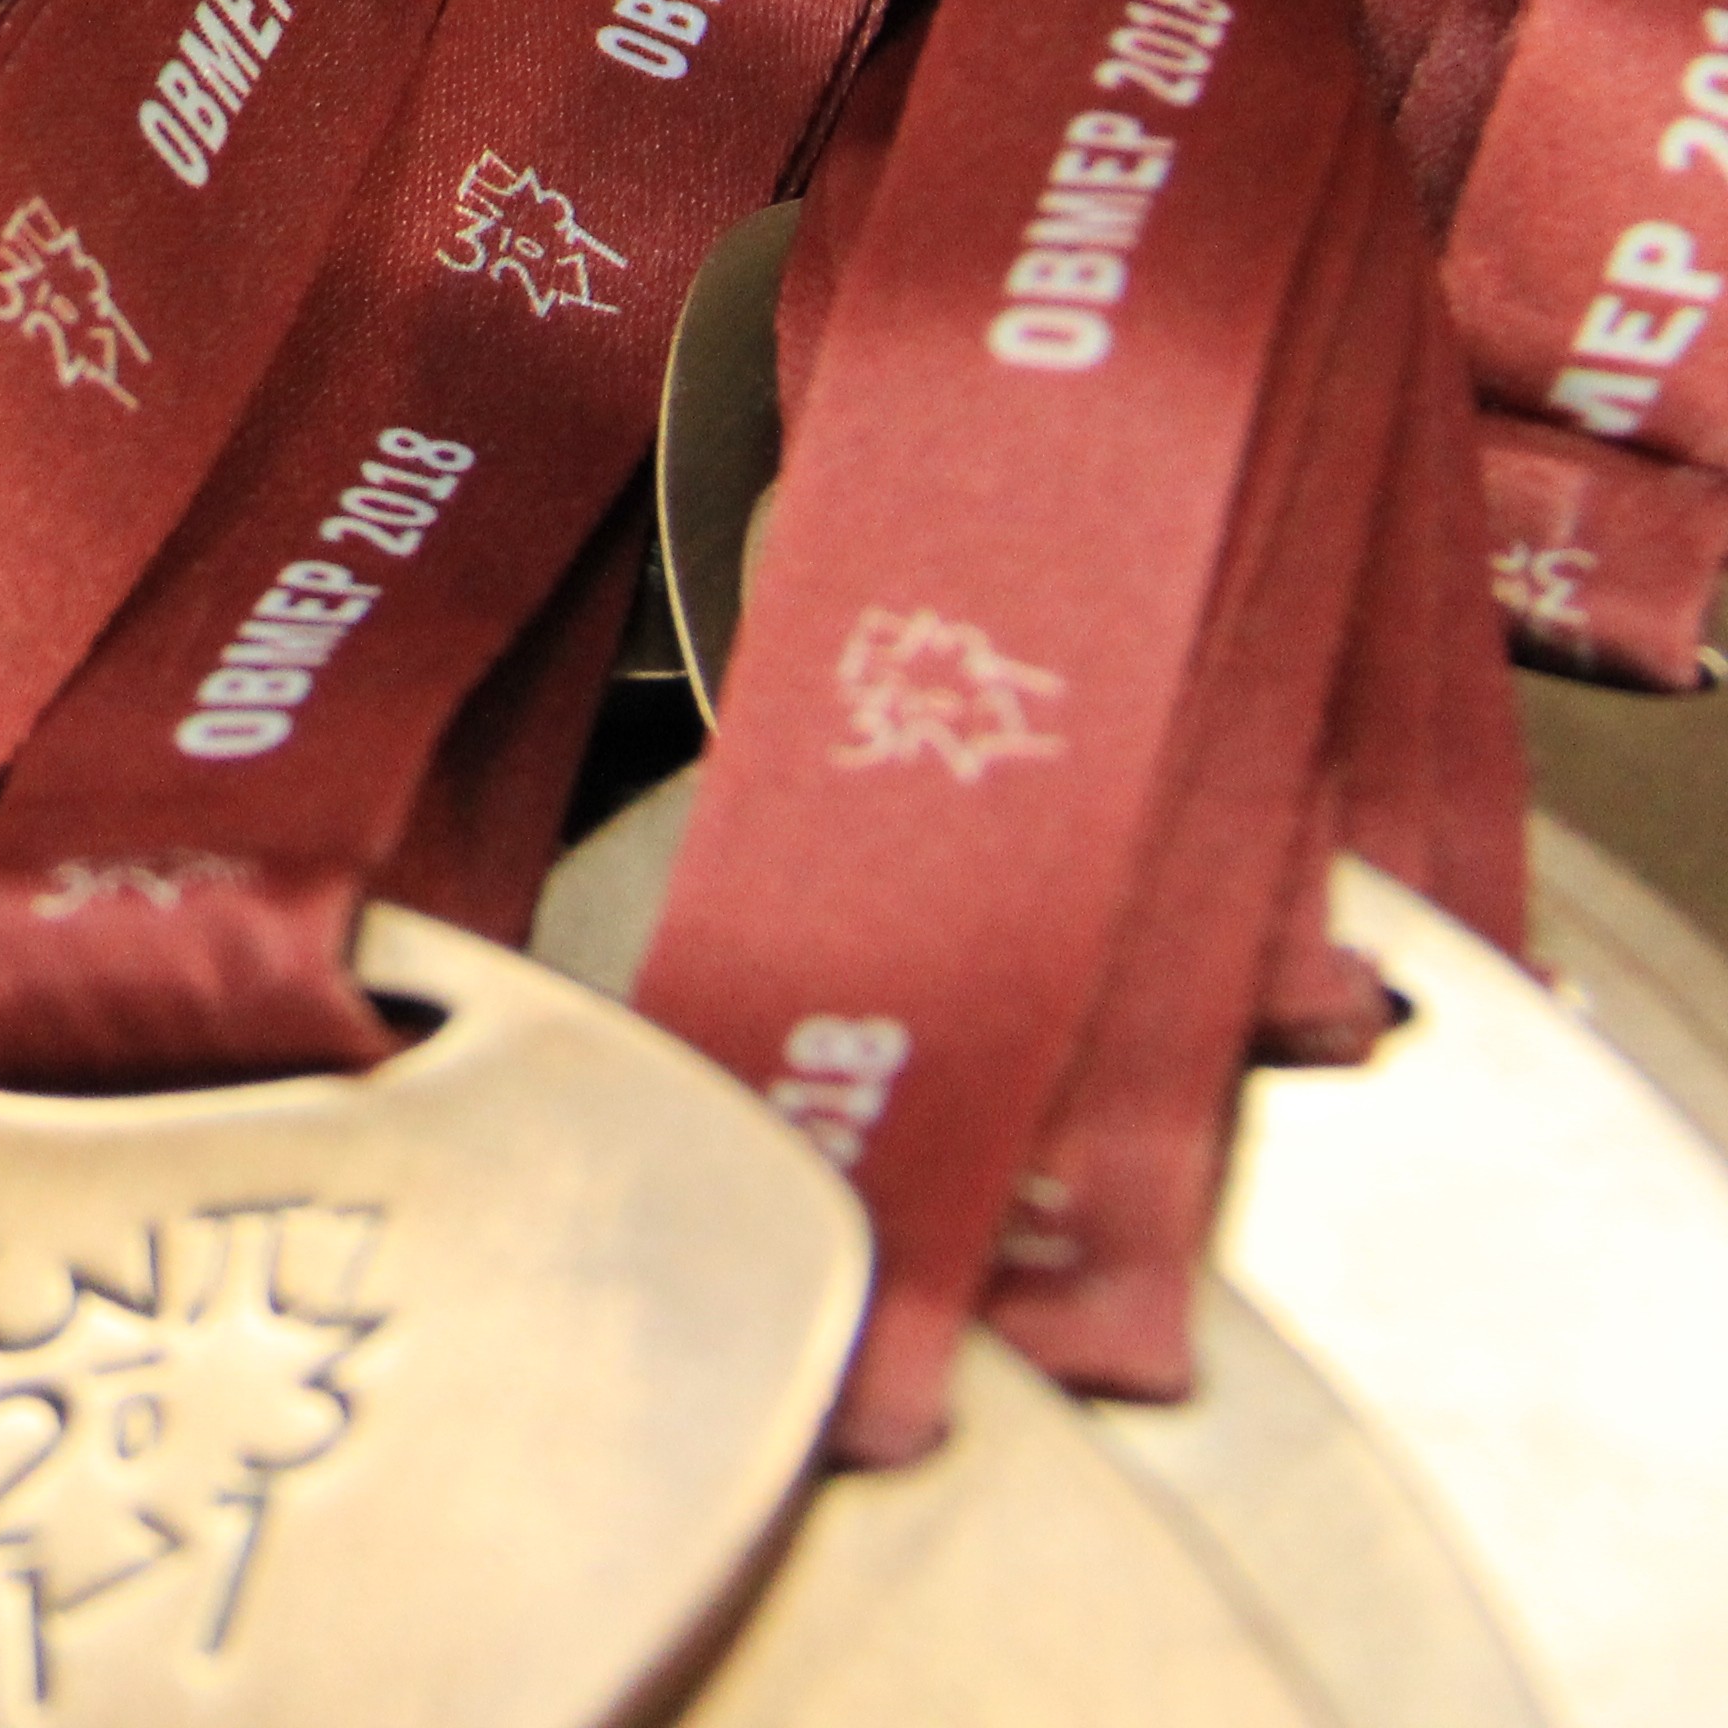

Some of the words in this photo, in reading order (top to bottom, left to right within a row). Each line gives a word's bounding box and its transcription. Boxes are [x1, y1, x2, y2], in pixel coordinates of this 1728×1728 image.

[985, 109, 1180, 372] OBMEP
[172, 557, 384, 760] OBMEP
[318, 424, 478, 558] 2018
